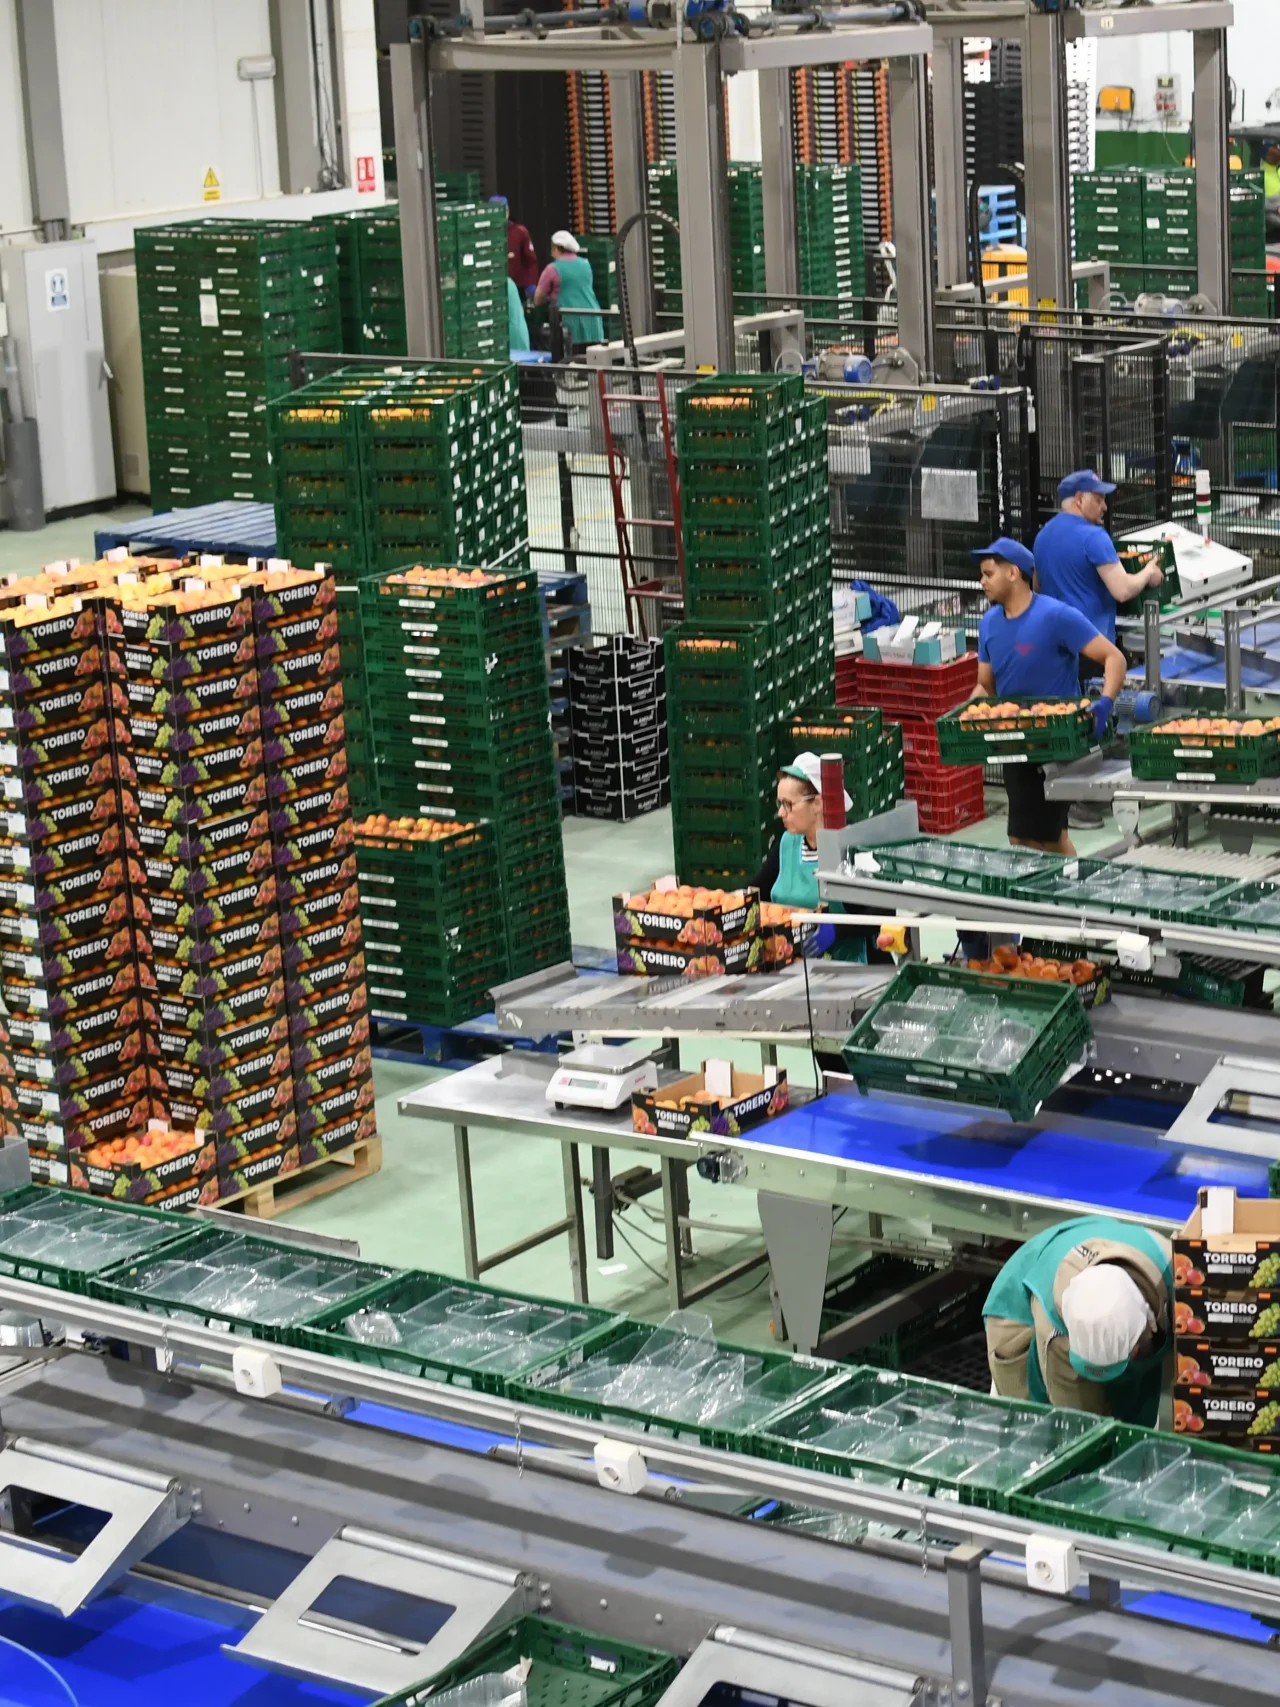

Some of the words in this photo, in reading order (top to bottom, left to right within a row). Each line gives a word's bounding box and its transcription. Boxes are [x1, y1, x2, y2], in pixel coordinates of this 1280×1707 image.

[278, 584, 317, 602] TORERO
[121, 609, 149, 622] TORERO
[190, 606, 231, 625] TORERO
[32, 618, 74, 638] TORERO
[281, 619, 319, 638] TORERO
[125, 652, 152, 665] TORERO
[197, 642, 237, 660] TORERO
[36, 655, 78, 675] TORERO
[283, 653, 321, 672] TORERO
[127, 683, 154, 695] TORERO
[196, 678, 237, 697] TORERO
[40, 692, 82, 713] TORERO
[285, 691, 323, 711] TORERO
[129, 718, 157, 731] TORERO
[199, 715, 240, 734] TORERO
[288, 724, 327, 744] TORERO
[43, 729, 85, 750] TORERO
[135, 756, 162, 769] TORERO
[203, 746, 243, 766] TORERO
[47, 765, 89, 785] TORERO
[291, 758, 329, 778] TORERO
[138, 790, 166, 803] TORERO
[208, 784, 246, 804] TORERO
[295, 793, 331, 813] TORERO
[52, 801, 94, 821] TORERO
[138, 826, 166, 839] TORERO
[210, 821, 248, 842] TORERO
[297, 828, 334, 848] TORERO
[58, 834, 99, 855] TORERO
[145, 859, 172, 872] TORERO
[212, 851, 250, 872] TORERO
[59, 870, 101, 891] TORERO
[301, 863, 338, 883] TORERO
[149, 897, 177, 911] TORERO
[218, 885, 257, 906] TORERO
[304, 893, 341, 913] TORERO
[65, 903, 106, 925] TORERO
[637, 912, 682, 931] TORERO
[721, 907, 747, 924] TORERO
[150, 930, 178, 944] TORERO
[221, 923, 259, 944] TORERO
[307, 925, 344, 946] TORERO
[68, 938, 109, 959] TORERO
[724, 942, 750, 957] TORERO
[222, 955, 261, 977] TORERO
[641, 950, 686, 969] TORERO
[154, 964, 182, 977] TORERO
[309, 962, 347, 983] TORERO
[72, 975, 113, 997] TORERO
[229, 986, 268, 1008] TORERO
[313, 994, 349, 1015] TORERO
[159, 1002, 187, 1015] TORERO
[76, 1009, 118, 1031] TORERO
[158, 1034, 186, 1048] TORERO
[231, 1026, 269, 1049] TORERO
[316, 1025, 352, 1047] TORERO
[81, 1040, 122, 1062] TORERO
[235, 1054, 273, 1077] TORERO
[316, 1057, 352, 1080] TORERO
[166, 1070, 193, 1083] TORERO
[84, 1077, 125, 1100] TORERO
[238, 1087, 275, 1109] TORERO
[170, 1102, 197, 1115] TORERO
[321, 1090, 357, 1112] TORERO
[733, 1090, 771, 1118] TORERO
[90, 1108, 130, 1131] TORERO
[655, 1109, 691, 1124] TORERO
[242, 1120, 279, 1142] TORERO
[322, 1121, 358, 1144] TORERO
[87, 1167, 115, 1181] TORERO
[156, 1153, 196, 1177] TORERO
[244, 1156, 281, 1179] TORERO
[159, 1188, 199, 1212] TORERO
[1203, 1252, 1257, 1265] TORERO
[1204, 1301, 1257, 1314] TORERO
[1210, 1355, 1264, 1368] TORERO
[1203, 1399, 1256, 1412] TORERO
